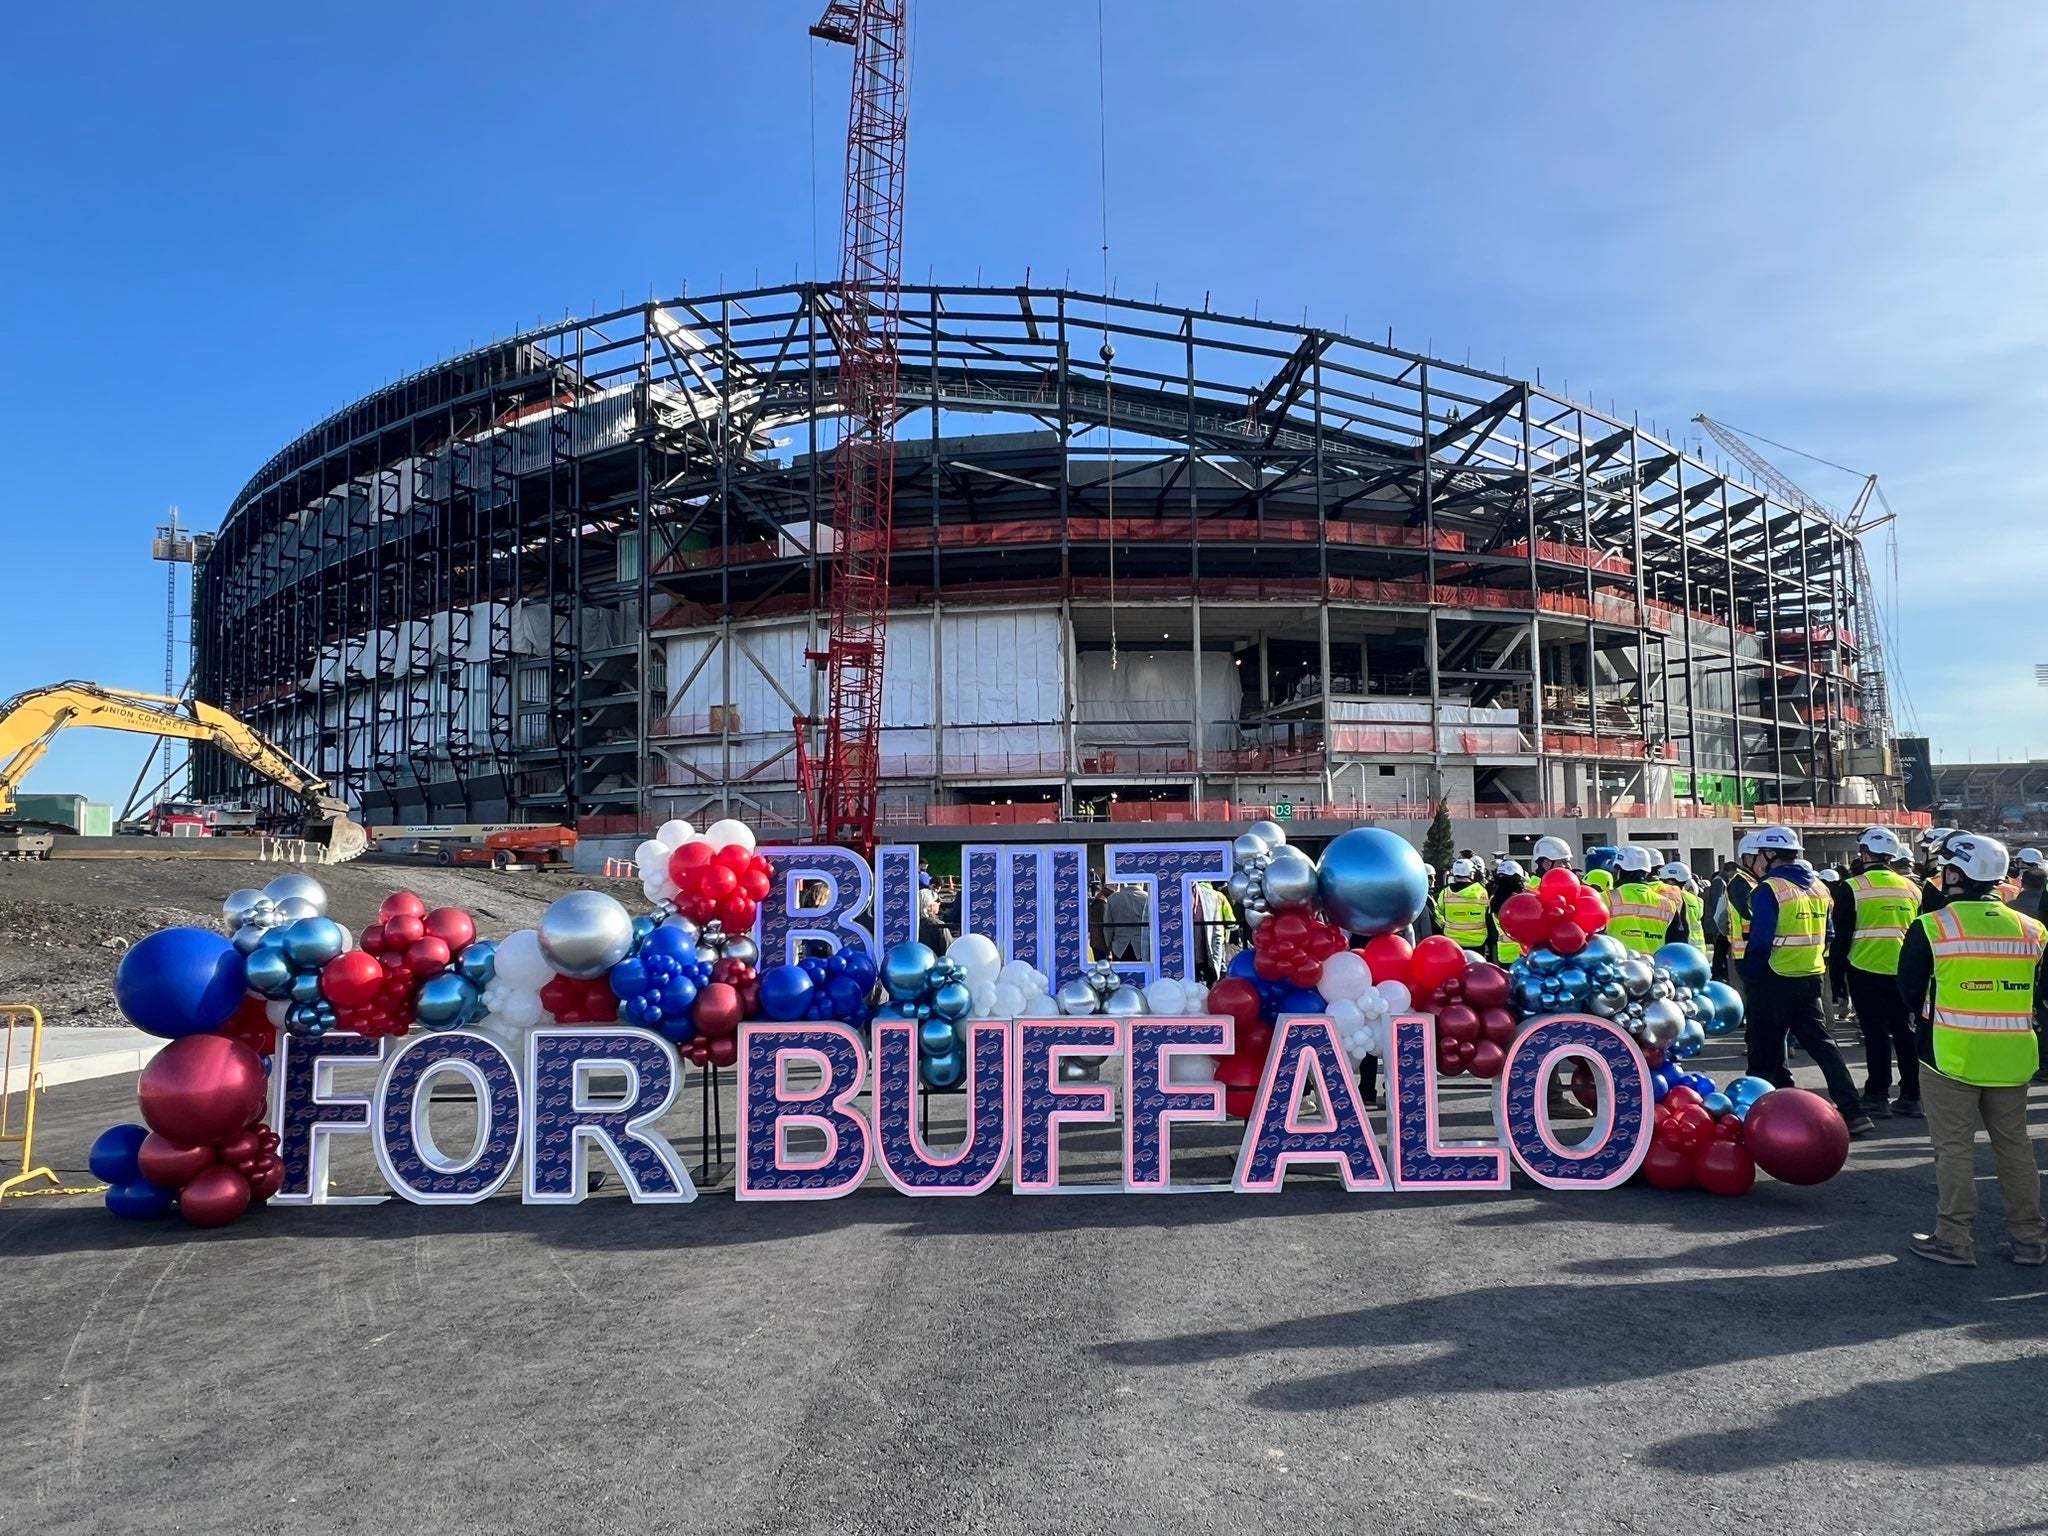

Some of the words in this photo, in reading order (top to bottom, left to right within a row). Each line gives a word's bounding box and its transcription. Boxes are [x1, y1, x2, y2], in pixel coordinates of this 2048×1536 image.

[102, 704, 134, 718] UNION
[138, 713, 190, 732] CONCRETE
[1276, 804, 1291, 816] D3
[753, 843, 1235, 998] BUILT
[266, 1026, 699, 1205] FOR
[735, 1012, 1655, 1201] BUFFALO
